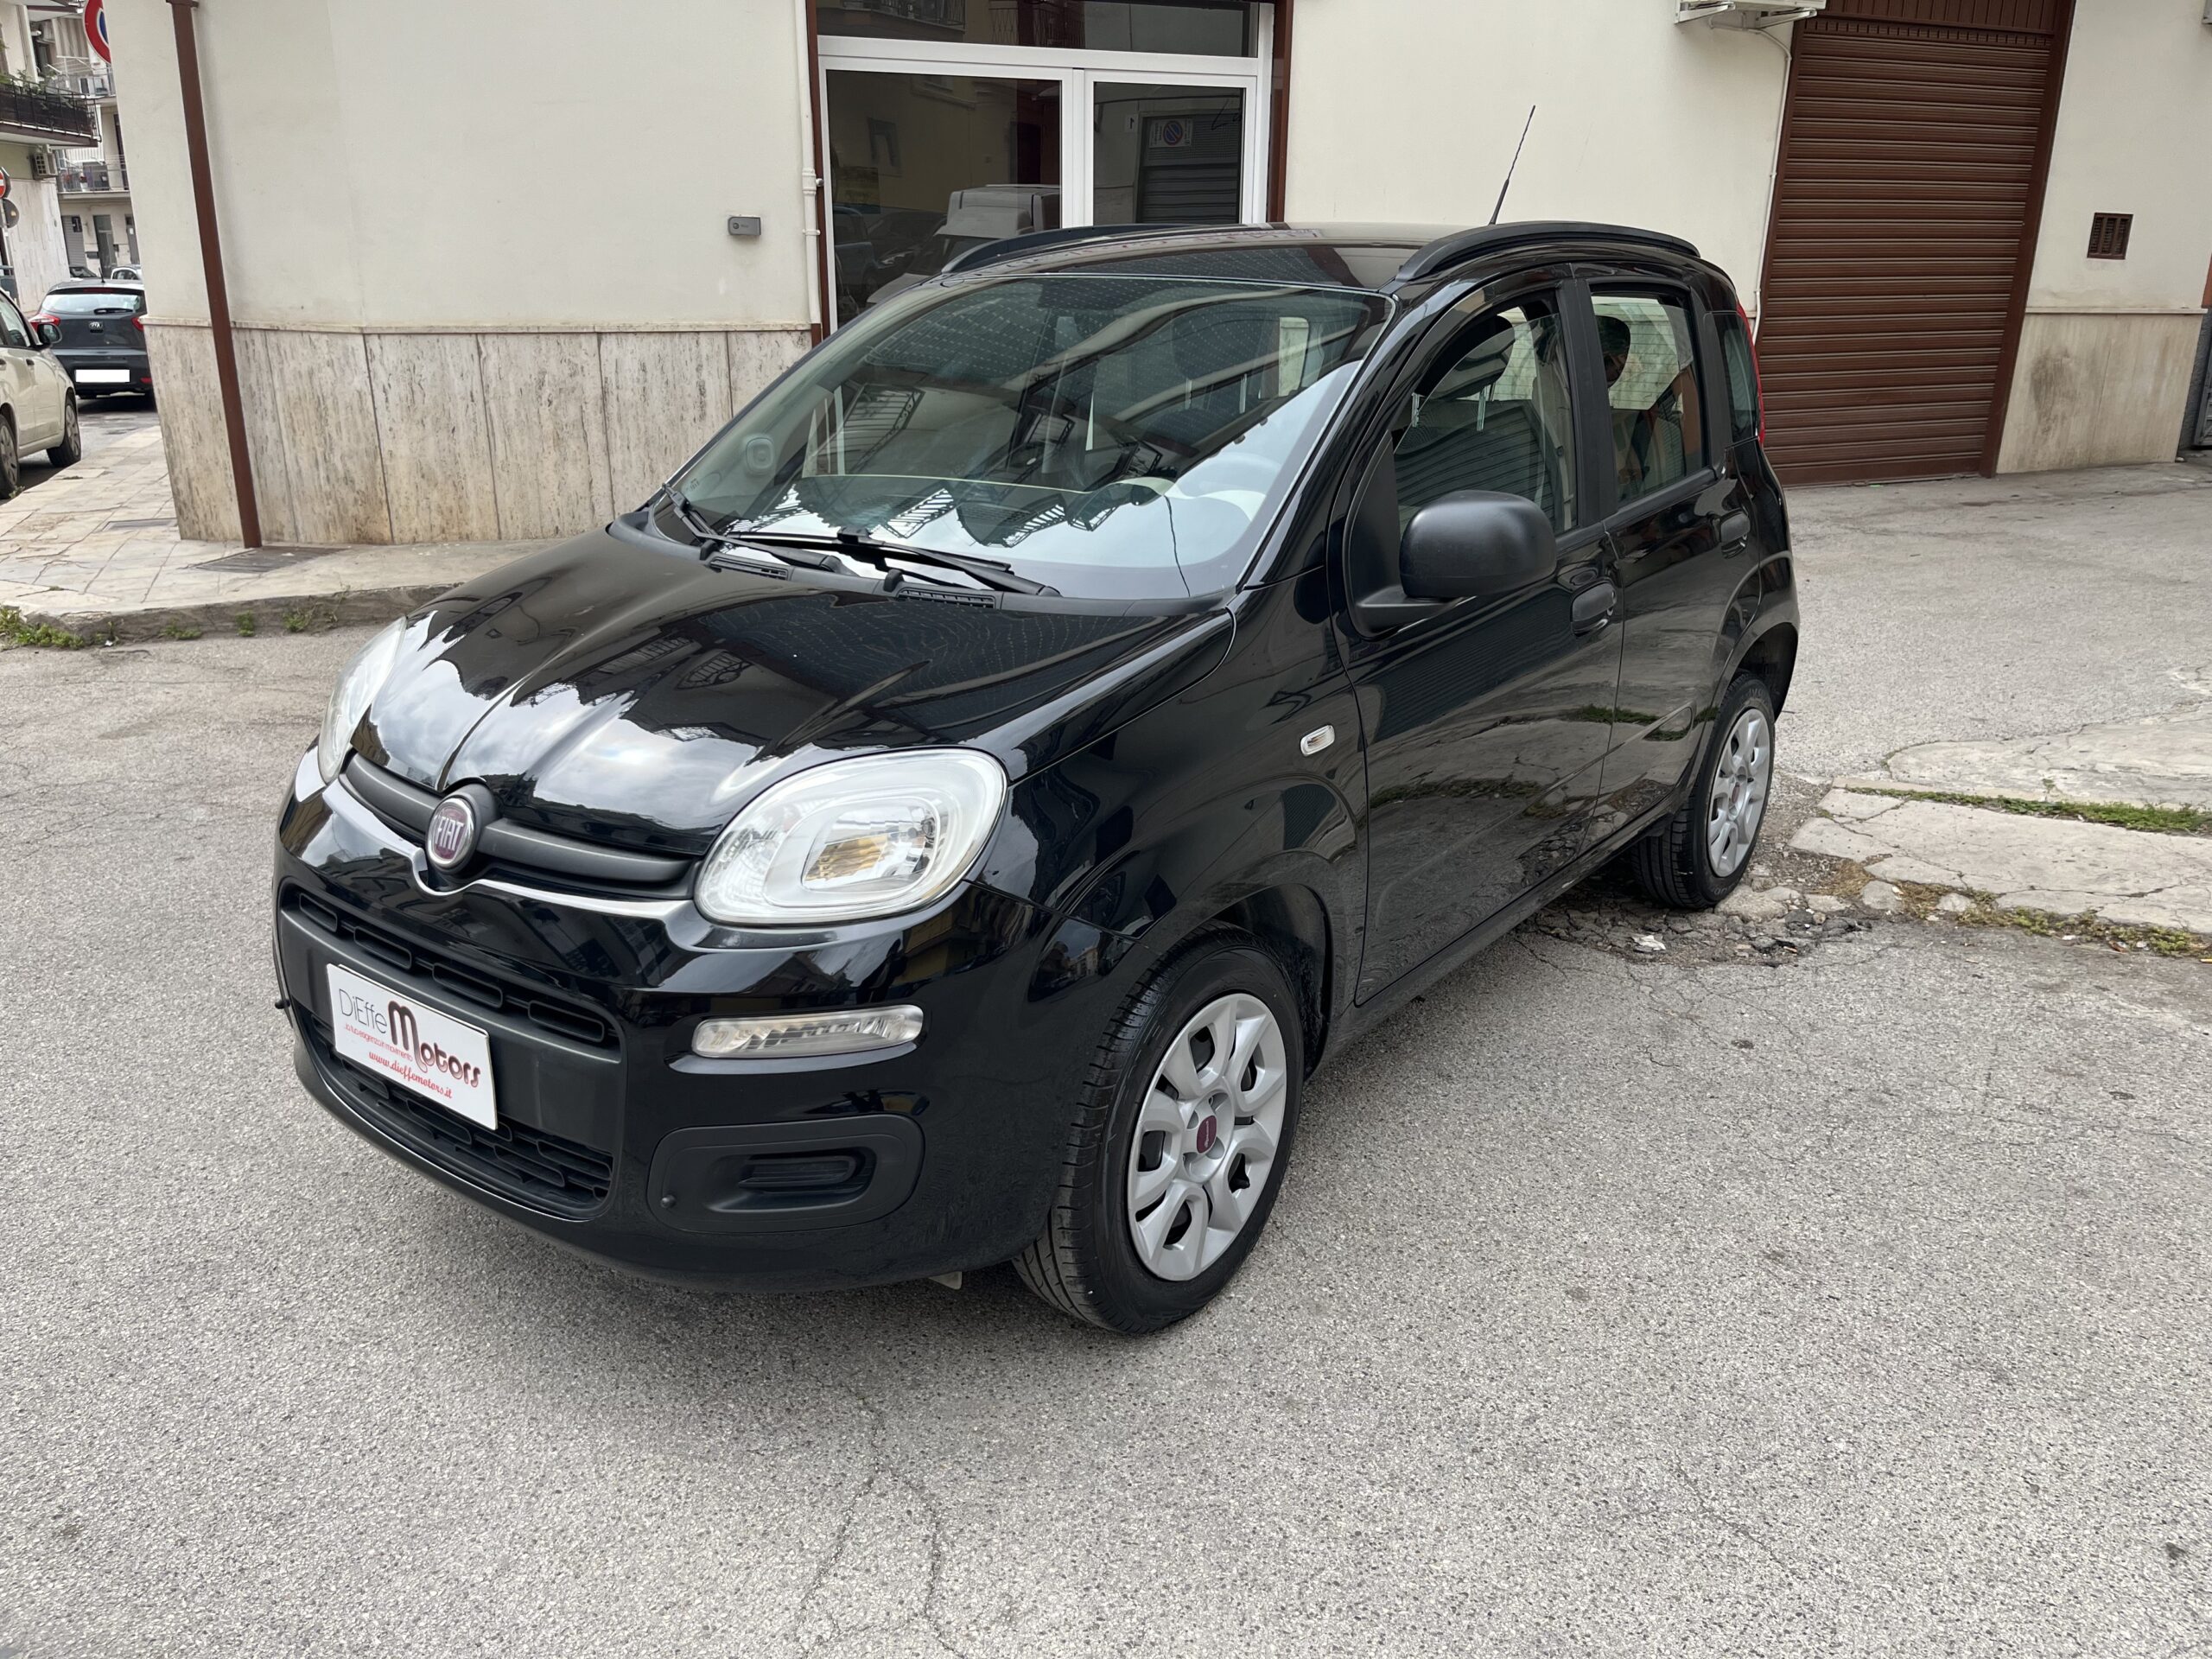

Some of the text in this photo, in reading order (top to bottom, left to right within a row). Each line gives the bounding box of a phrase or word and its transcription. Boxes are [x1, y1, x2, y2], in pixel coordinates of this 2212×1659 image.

[434, 815, 465, 851] FIAT
[339, 988, 481, 1088] DiEffe Motors
[369, 1051, 454, 1100] www.dieffemotors.it
